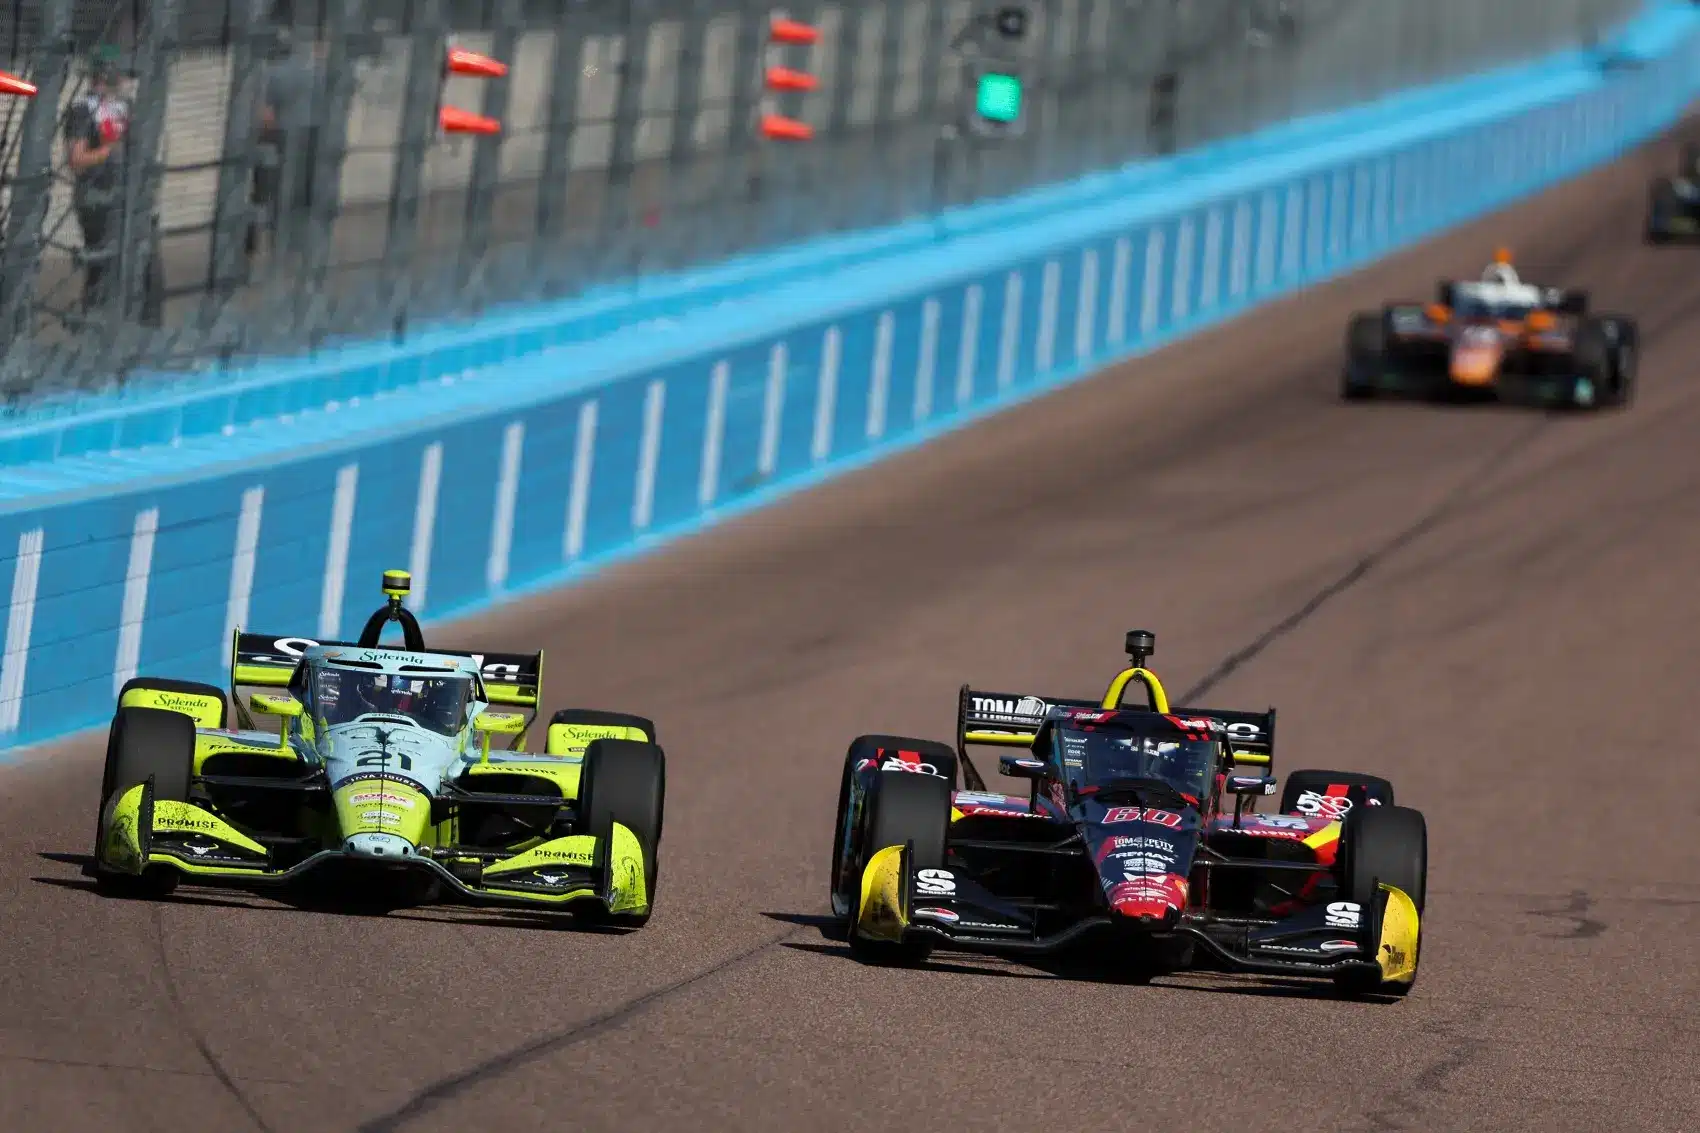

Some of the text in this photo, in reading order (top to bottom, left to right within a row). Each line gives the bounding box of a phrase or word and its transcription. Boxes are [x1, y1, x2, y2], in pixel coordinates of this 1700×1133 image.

[359, 650, 424, 665] Splenda
[153, 694, 208, 708] Splenda
[971, 697, 1014, 722] TOM
[562, 726, 617, 740] Splenda
[356, 750, 412, 771] 21
[483, 764, 558, 776] Firestone
[157, 817, 219, 829] PROMISE
[1101, 806, 1182, 828] 60
[1114, 836, 1133, 846] TOM
[1149, 838, 1174, 851] PETTY
[534, 849, 595, 861] PROMISE
